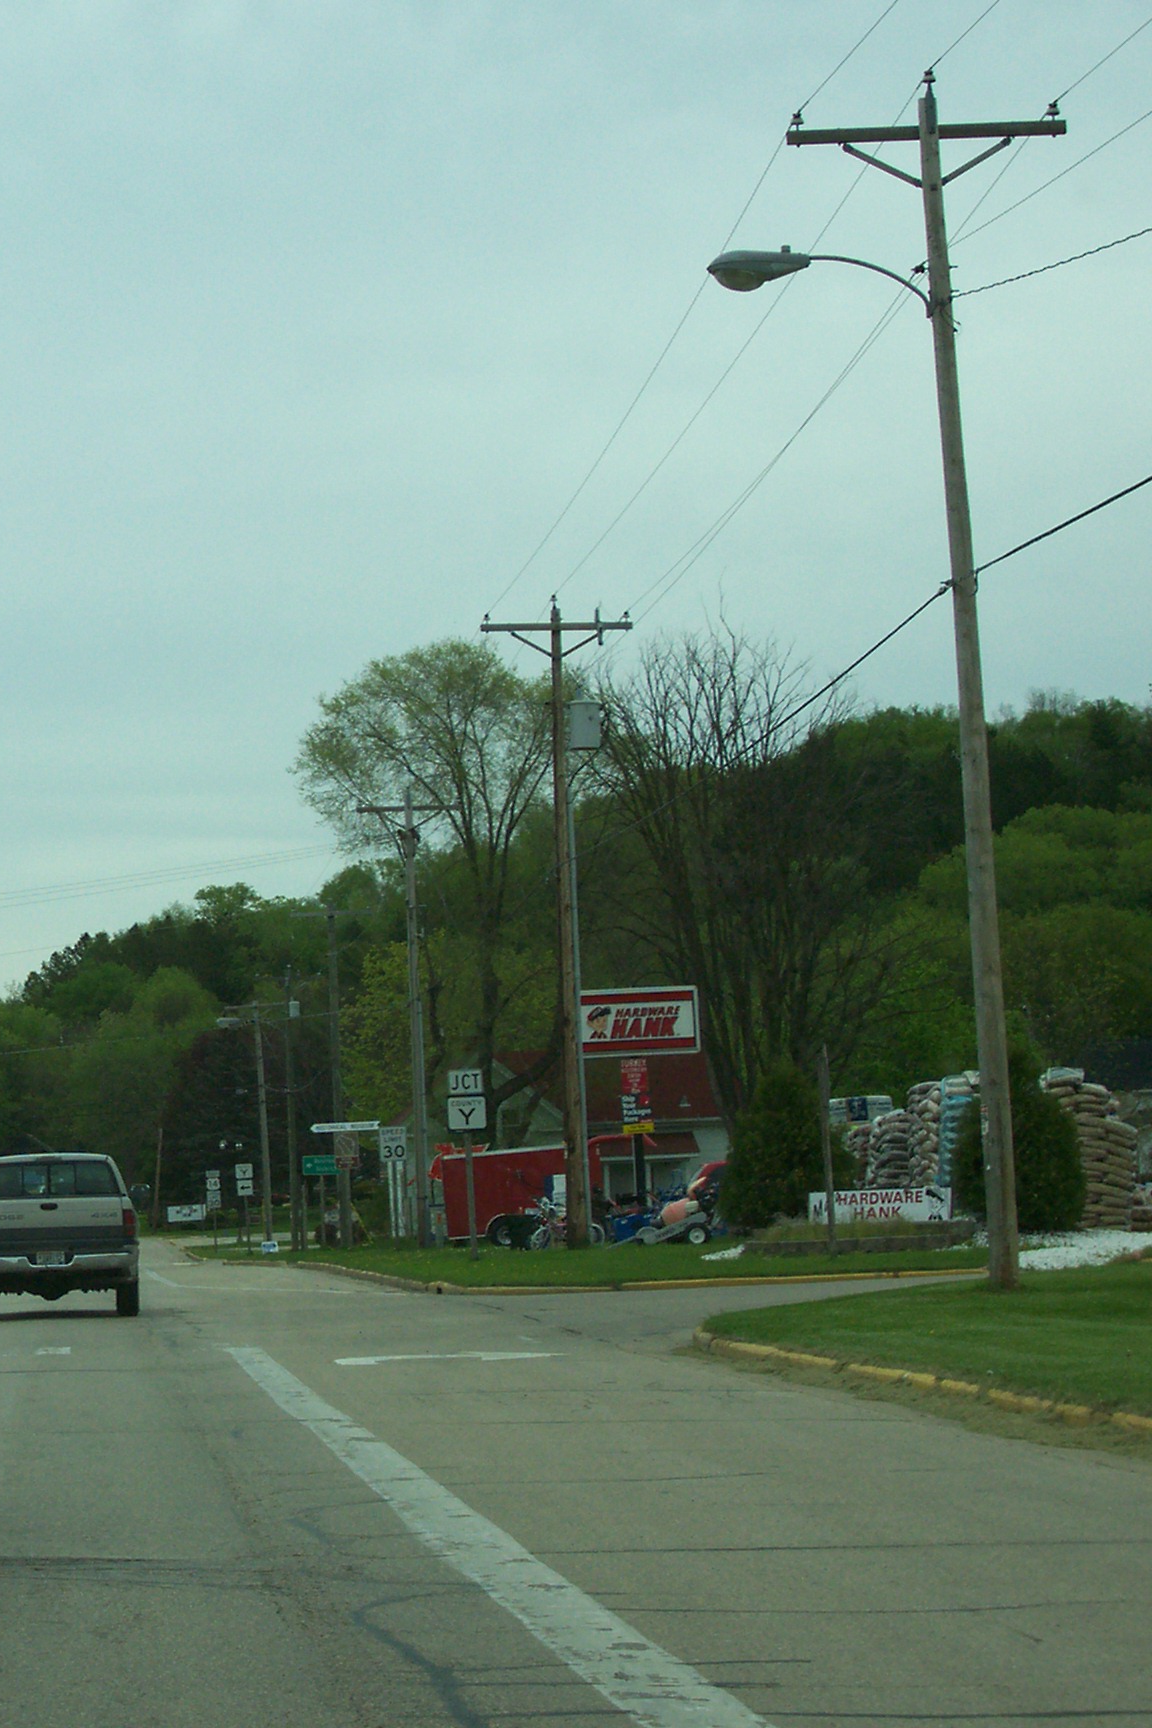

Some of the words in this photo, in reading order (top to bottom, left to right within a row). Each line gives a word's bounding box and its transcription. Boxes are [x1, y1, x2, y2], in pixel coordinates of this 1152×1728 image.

[615, 1006, 680, 1018] HARDWARE
[611, 1017, 678, 1039] HANK
[451, 1073, 480, 1090] JCT
[458, 1107, 476, 1125] Y
[381, 1128, 404, 1136] SPEED
[383, 1135, 402, 1143] LIMIT
[383, 1144, 405, 1159] 30
[837, 1190, 923, 1205] HARDWARE
[854, 1206, 901, 1220] HANK
